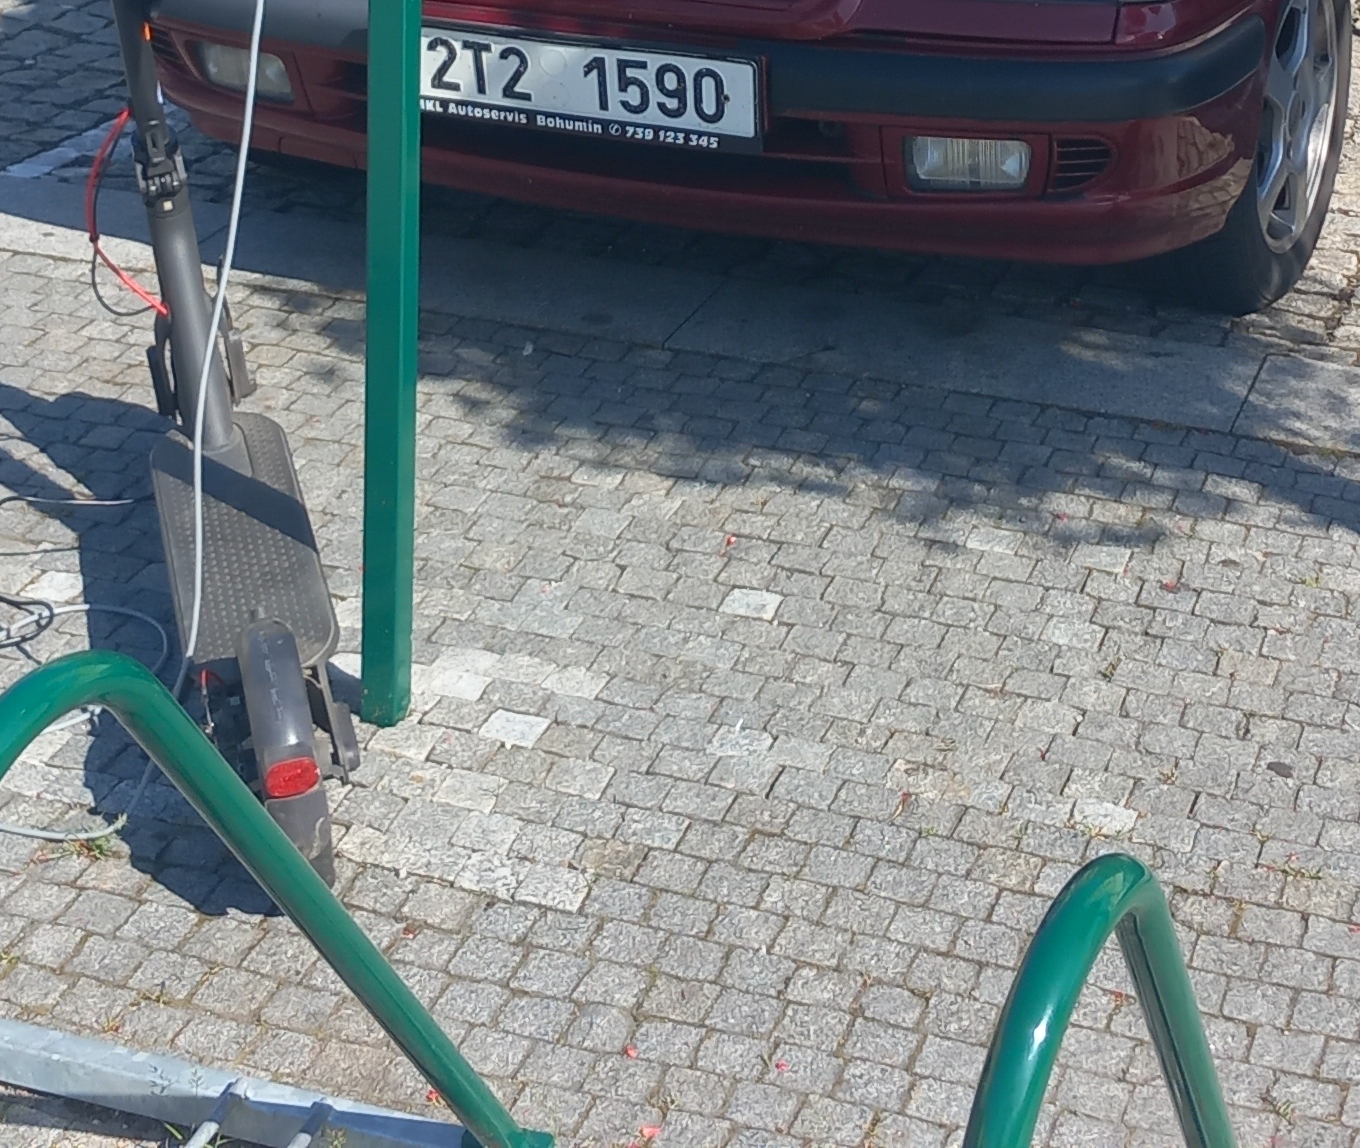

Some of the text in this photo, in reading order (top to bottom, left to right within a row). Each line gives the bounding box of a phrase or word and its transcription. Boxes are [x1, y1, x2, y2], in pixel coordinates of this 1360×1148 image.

[426, 37, 726, 124] 2T2 1590
[448, 102, 528, 124] Autoservis
[536, 114, 603, 134] Bohumín
[658, 131, 685, 145] 123
[688, 134, 720, 149] 345
